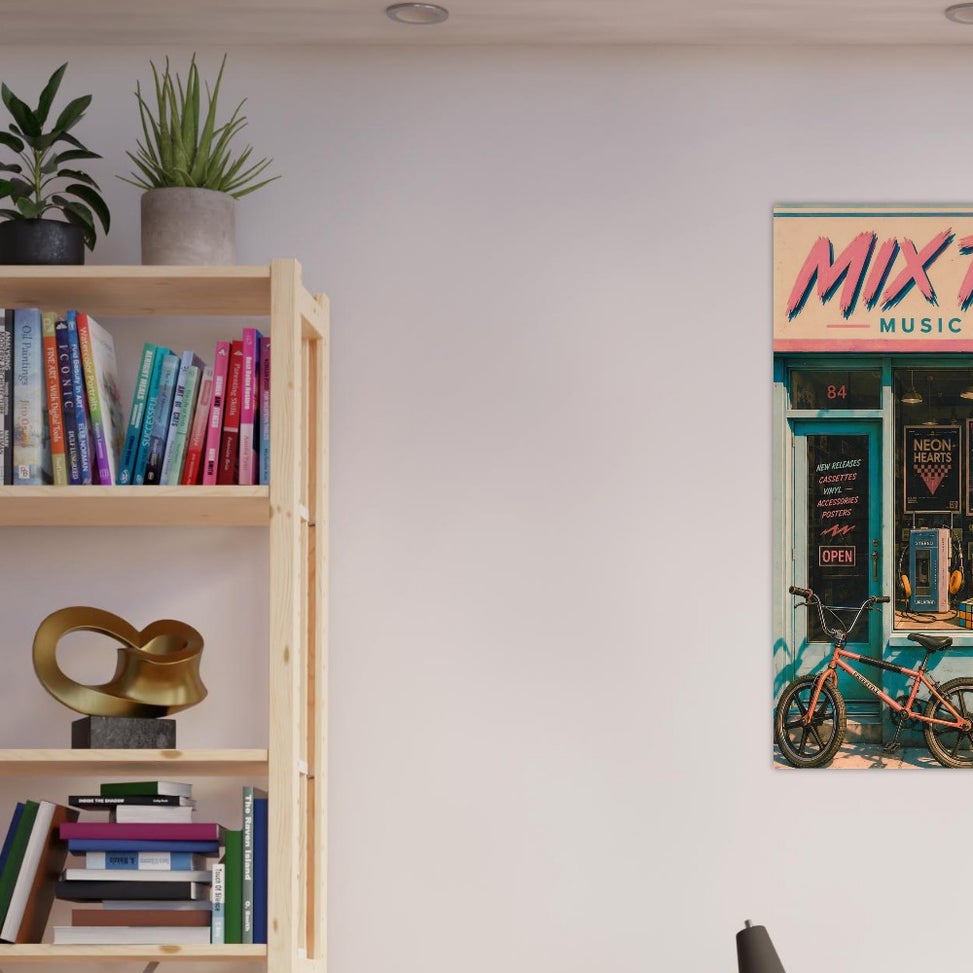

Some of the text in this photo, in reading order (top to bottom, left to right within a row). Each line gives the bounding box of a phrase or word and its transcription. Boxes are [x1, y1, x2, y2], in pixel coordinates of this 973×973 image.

[786, 227, 956, 320] MIX
[879, 317, 962, 333] MUSIC
[18, 325, 32, 385] Oil Paintings
[59, 345, 73, 408] ICONIC
[80, 327, 98, 411] Watercolor Portraits
[231, 363, 240, 396] Parenting
[826, 384, 848, 400] 84
[142, 397, 158, 447] SUCCESSFUL
[53, 425, 62, 443] Tools
[816, 459, 861, 472] NEW RELEASES
[913, 452, 953, 463] HEARTS
[818, 472, 858, 484] CASSETTES
[823, 486, 842, 495] VINYL
[817, 496, 859, 507] ACCESSORIES
[822, 508, 852, 519] POSTERS
[822, 550, 853, 563] OPEN
[244, 795, 252, 880] The Raven Island
[214, 868, 222, 884] Touch
